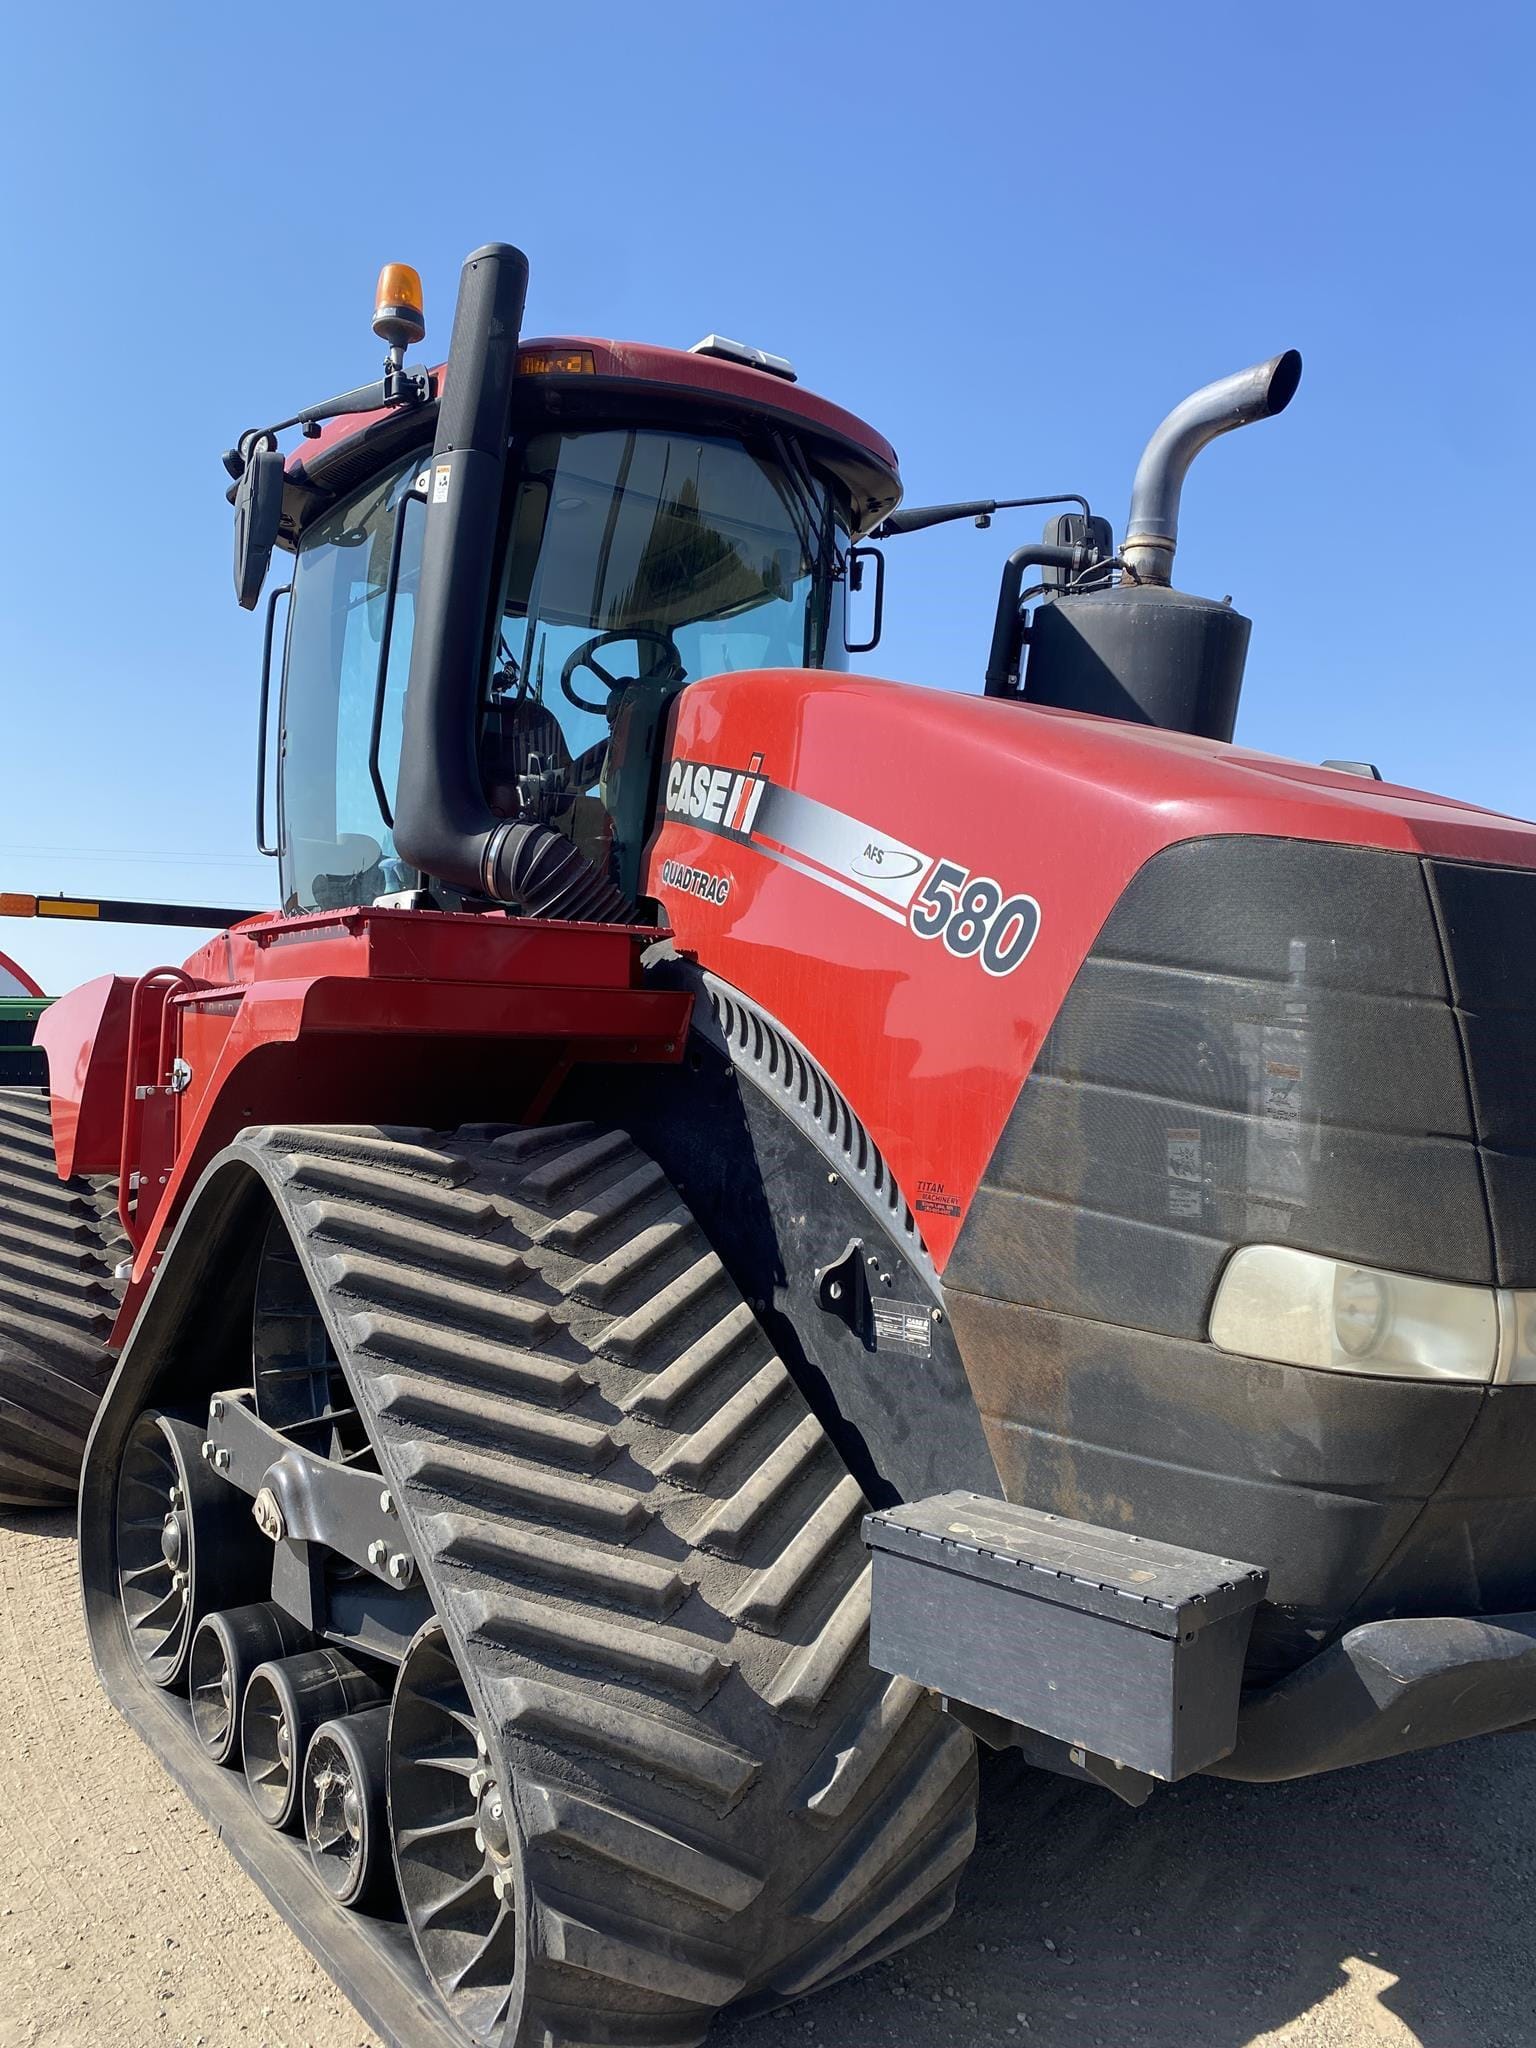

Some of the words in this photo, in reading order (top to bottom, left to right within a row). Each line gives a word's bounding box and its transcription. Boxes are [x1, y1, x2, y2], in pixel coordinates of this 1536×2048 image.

[666, 761, 732, 824] CASE
[863, 843, 885, 865] AFS
[662, 859, 730, 906] QUADTRAC
[910, 857, 1041, 977] 580
[917, 1180, 945, 1193] TITAN
[921, 1193, 960, 1205] MACHINERY
